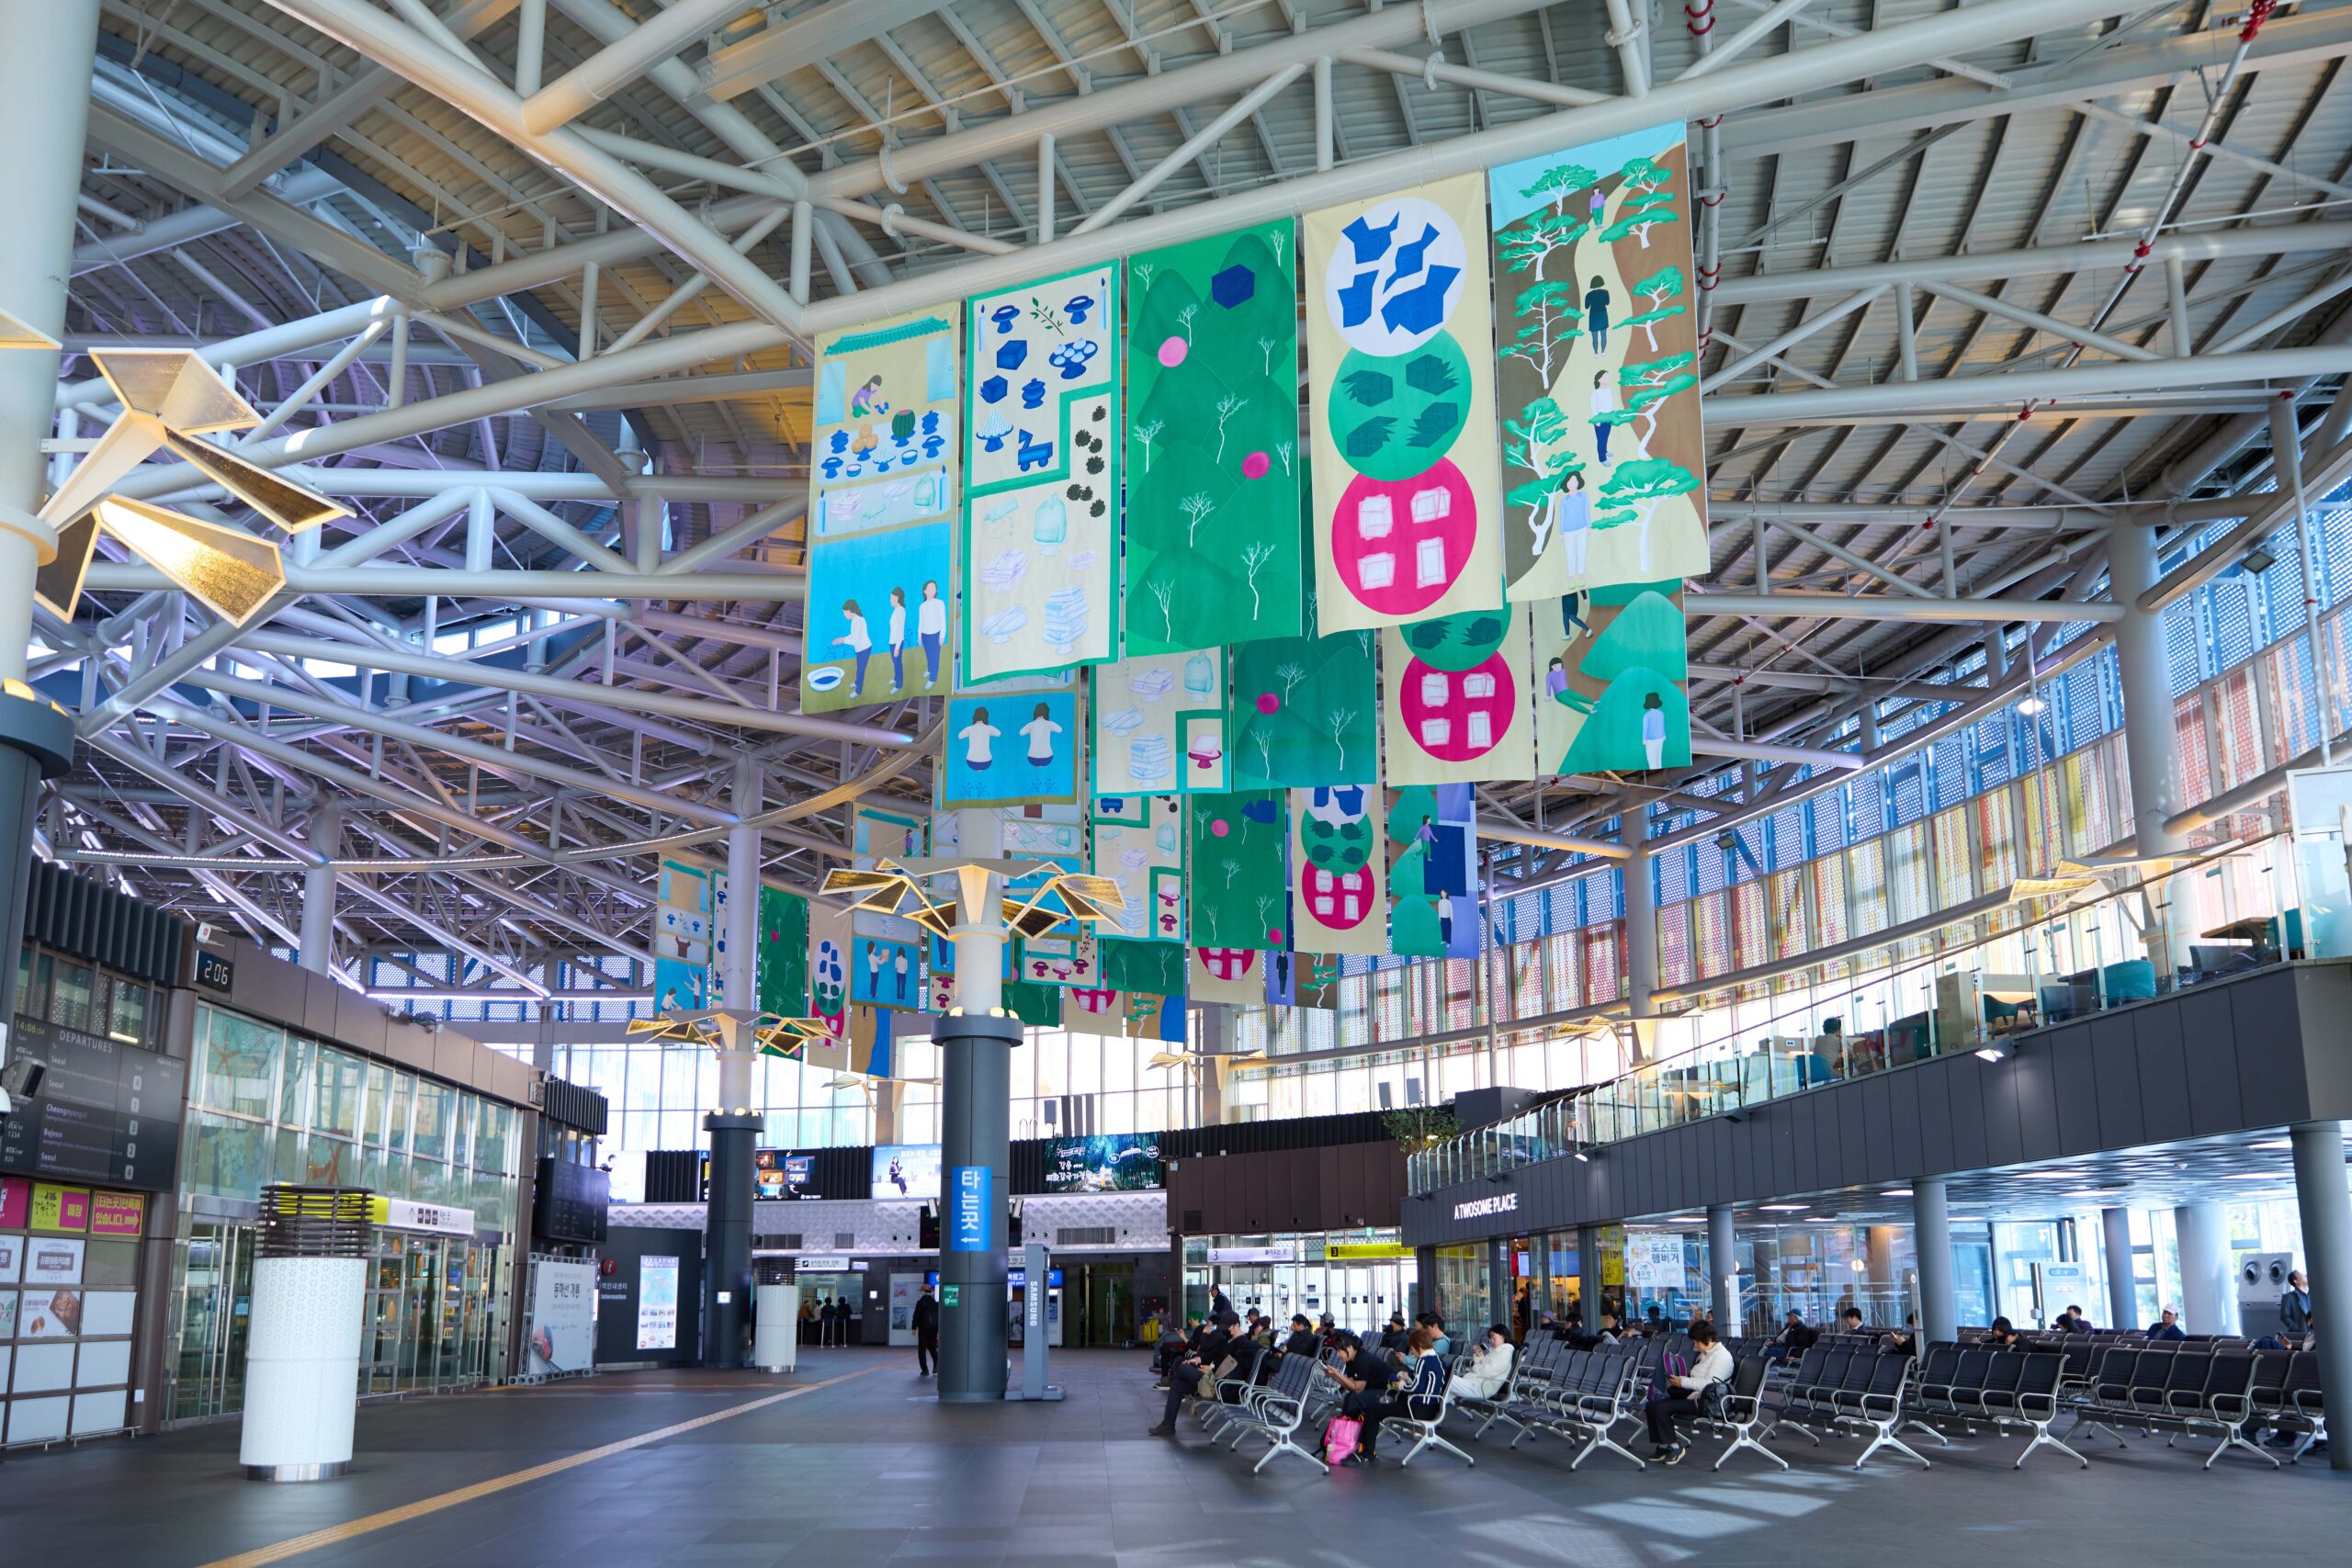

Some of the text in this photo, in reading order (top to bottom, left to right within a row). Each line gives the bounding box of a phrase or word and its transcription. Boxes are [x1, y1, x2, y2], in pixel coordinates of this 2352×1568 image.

[205, 960, 228, 985] 206
[60, 1030, 113, 1054] DEPARTURES
[51, 1055, 66, 1066] Seoul
[49, 1078, 64, 1089] Seoul
[43, 1128, 62, 1139] Bujeon
[40, 1152, 57, 1162] Seoul
[961, 1170, 980, 1231] 타는곳
[1454, 1193, 1518, 1220] A TWOSOME PLACE
[67, 1203, 83, 1218] 매장
[1213, 1250, 1219, 1261] 3
[1030, 1281, 1038, 1326] SAMSUNG
